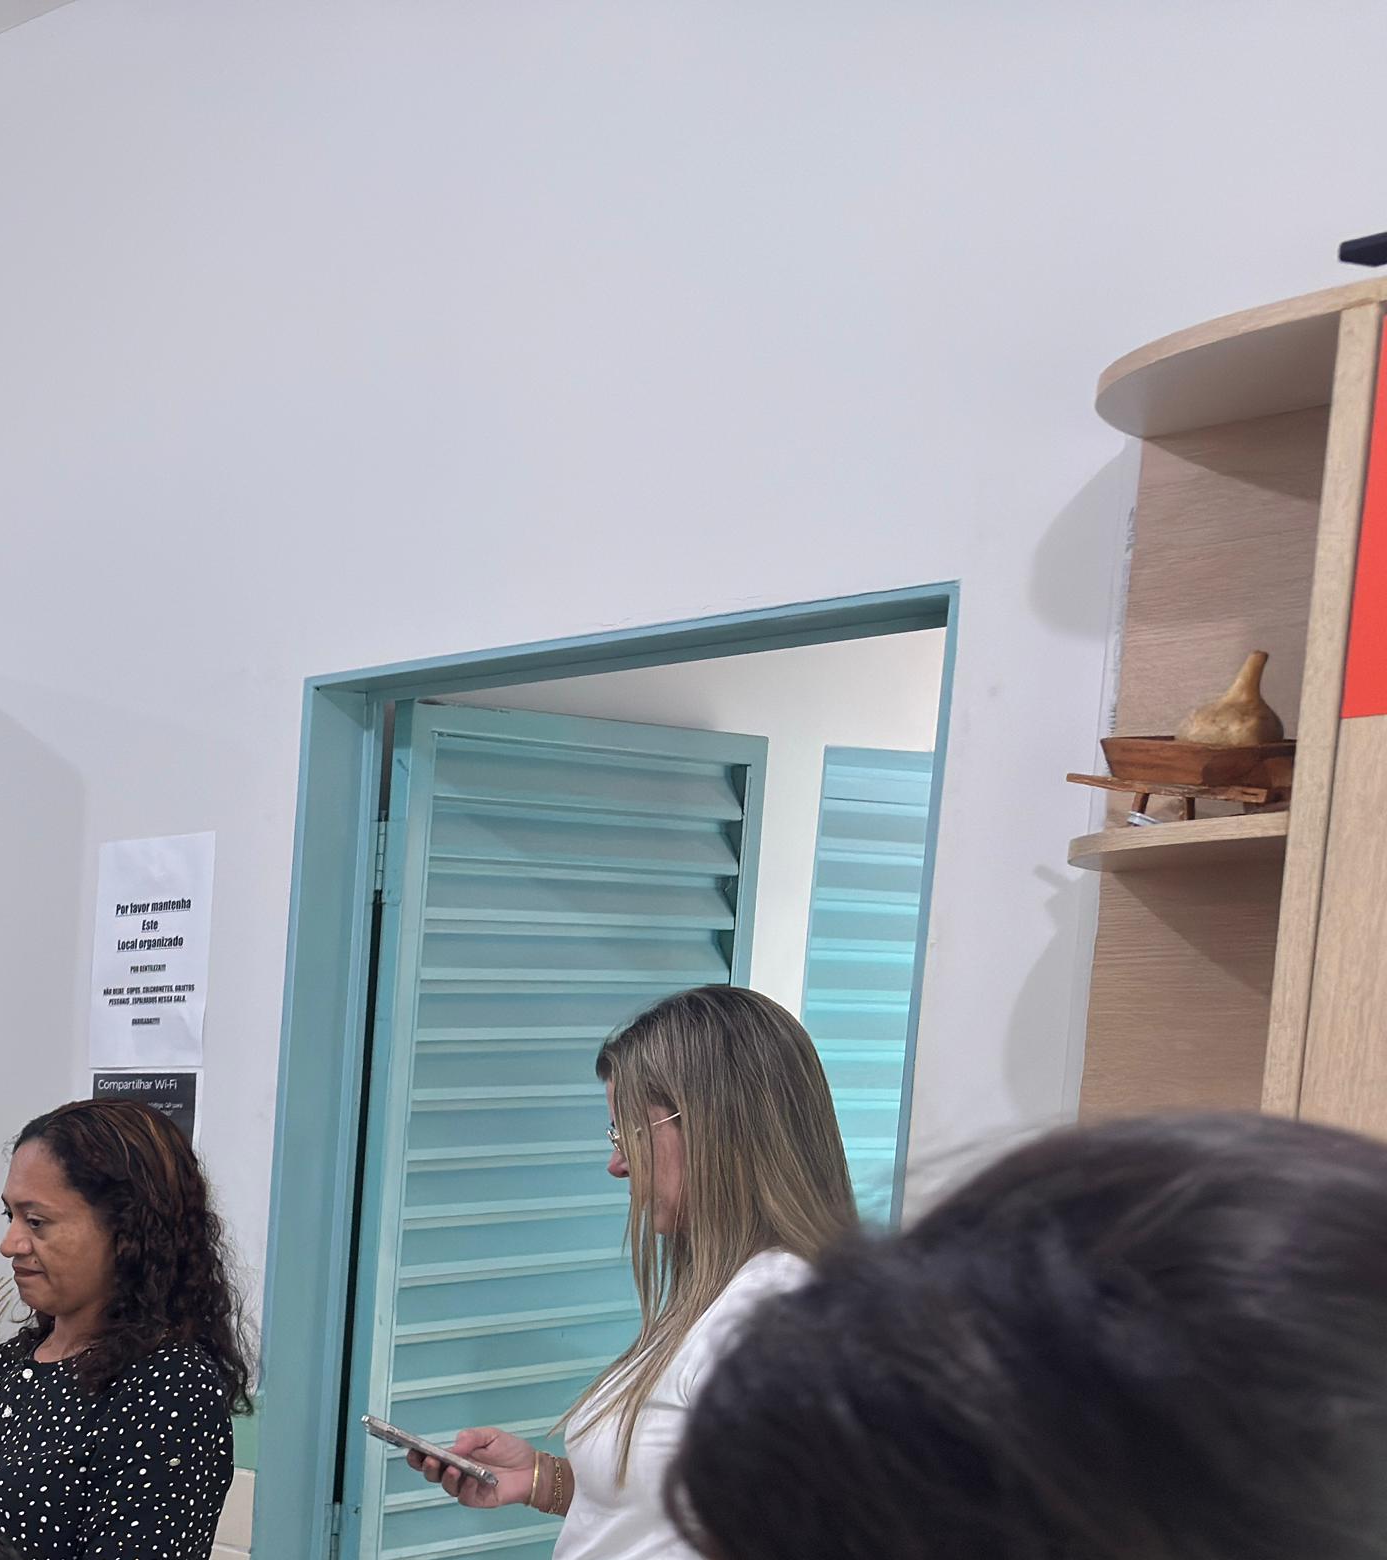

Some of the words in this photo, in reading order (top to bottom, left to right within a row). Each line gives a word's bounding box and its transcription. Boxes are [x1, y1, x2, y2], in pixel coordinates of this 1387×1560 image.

[115, 903, 129, 915] Por
[130, 902, 150, 914] favor
[151, 898, 192, 911] mantenha
[141, 919, 159, 931] Este
[117, 938, 138, 951] Local
[138, 935, 184, 950] organizado
[97, 1079, 153, 1091] Compartilhar
[155, 1079, 178, 1090] Wi-Fi
